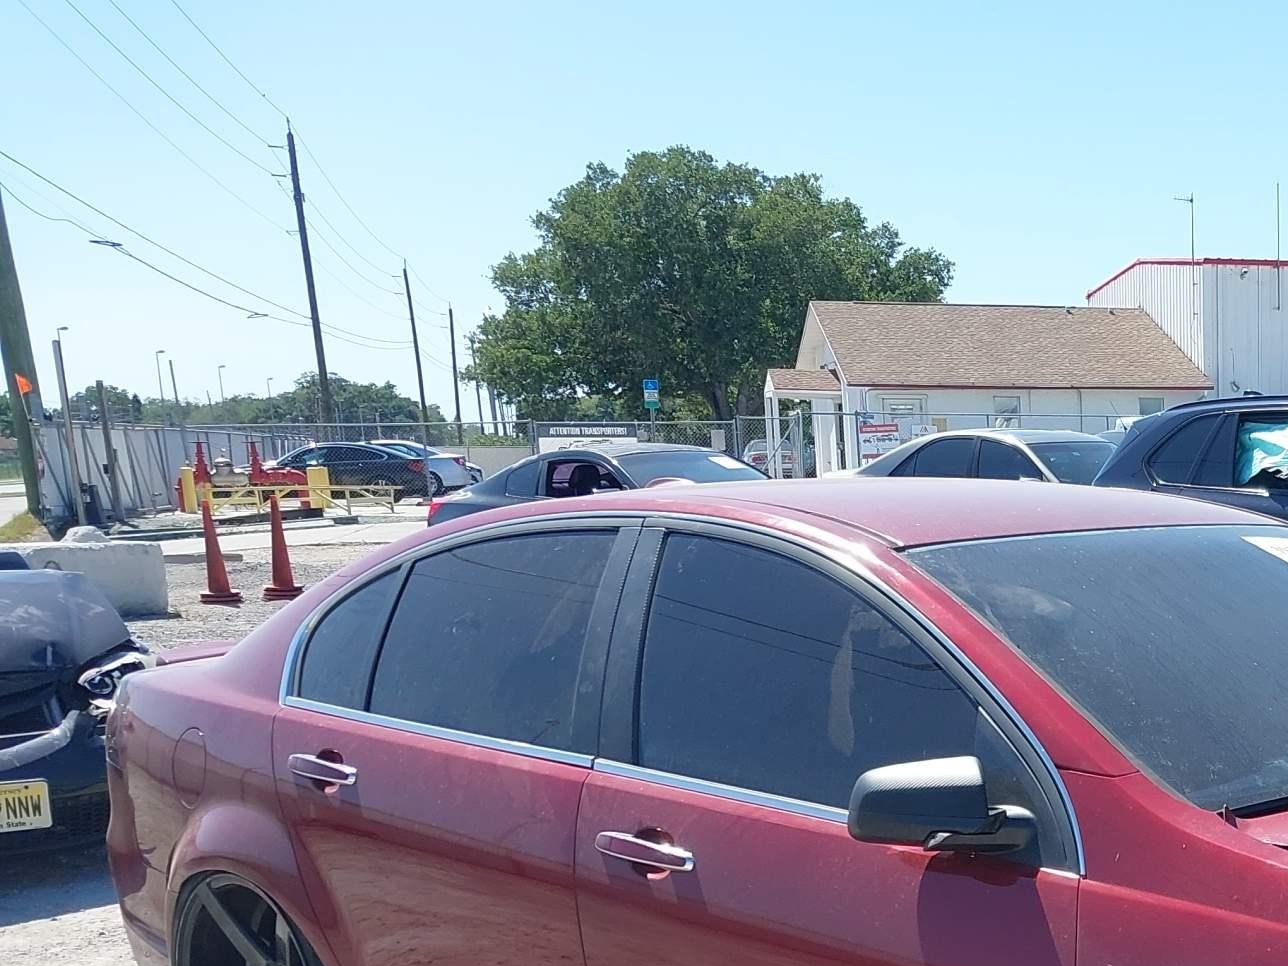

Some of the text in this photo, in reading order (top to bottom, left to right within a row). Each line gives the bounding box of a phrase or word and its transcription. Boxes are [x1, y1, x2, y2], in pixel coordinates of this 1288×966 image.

[549, 426, 627, 435] ATTENTION TRANSPORTERS!
[0, 794, 42, 820] NNW
